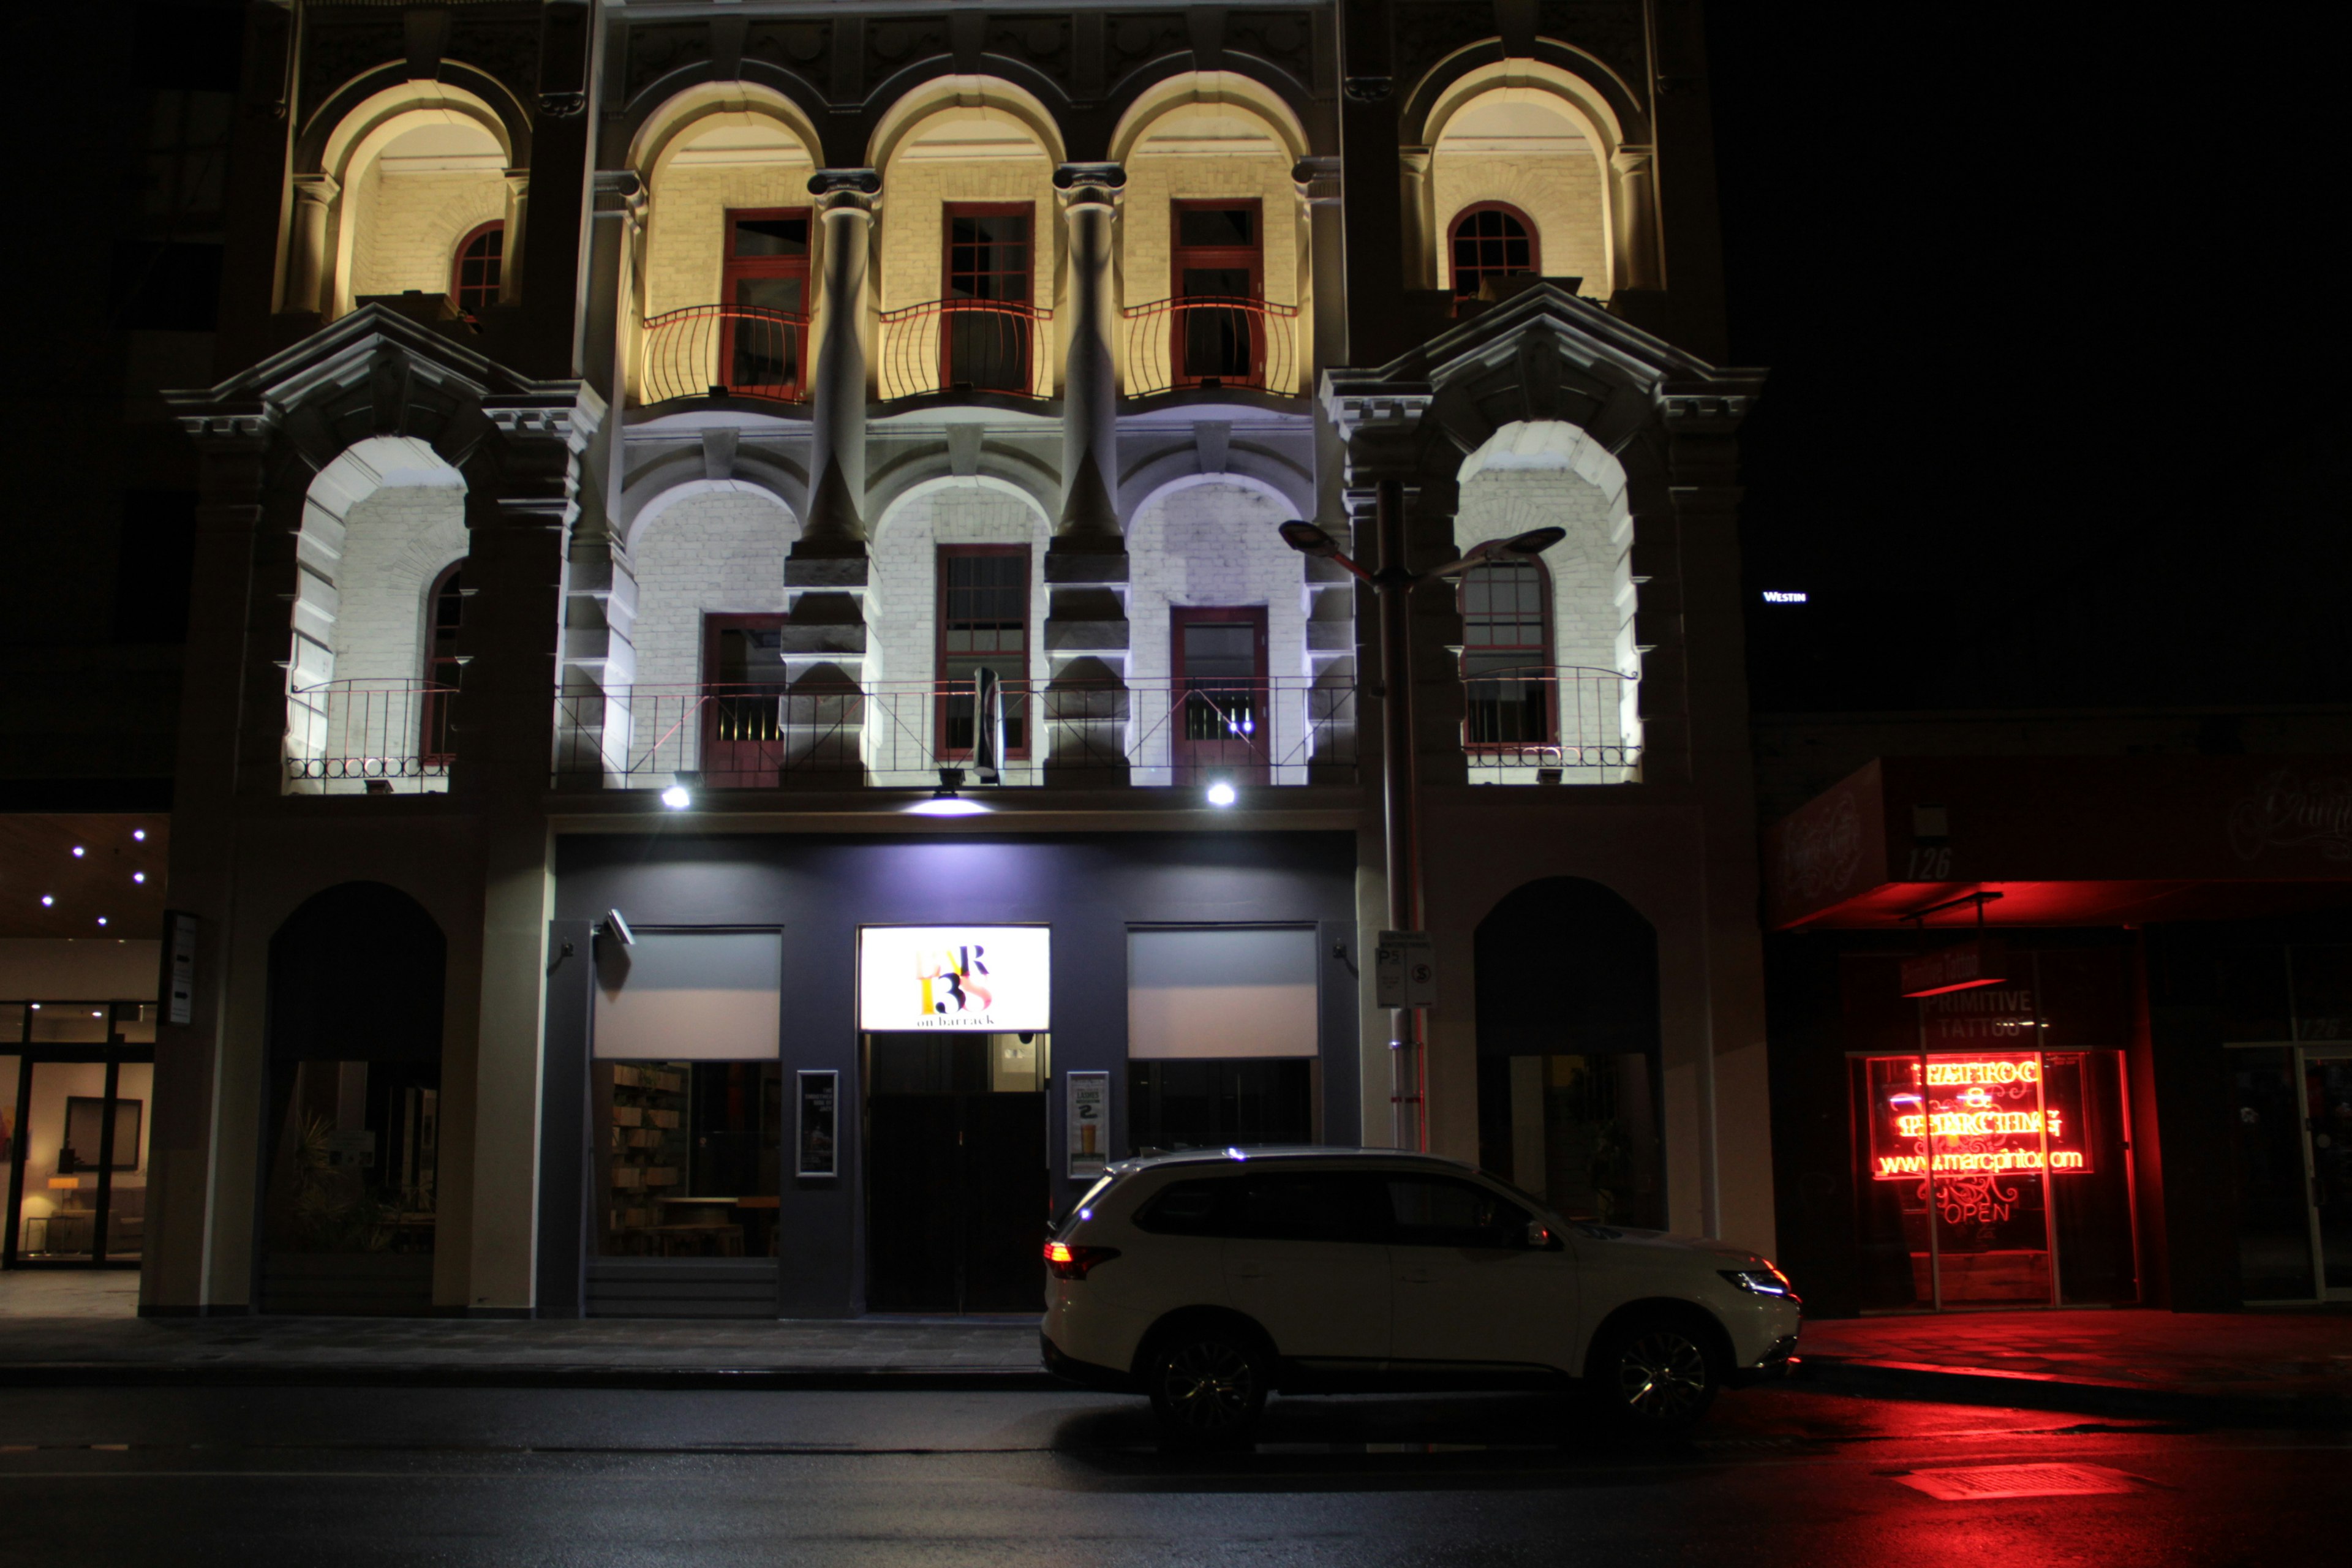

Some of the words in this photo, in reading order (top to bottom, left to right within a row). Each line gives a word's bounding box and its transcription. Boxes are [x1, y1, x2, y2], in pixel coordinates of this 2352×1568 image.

[1907, 847, 1953, 880] 126
[1925, 990, 2032, 1013] PRIMITIVE
[1936, 1016, 2020, 1038] TATTOO
[1944, 1202, 2010, 1224] OPEN
